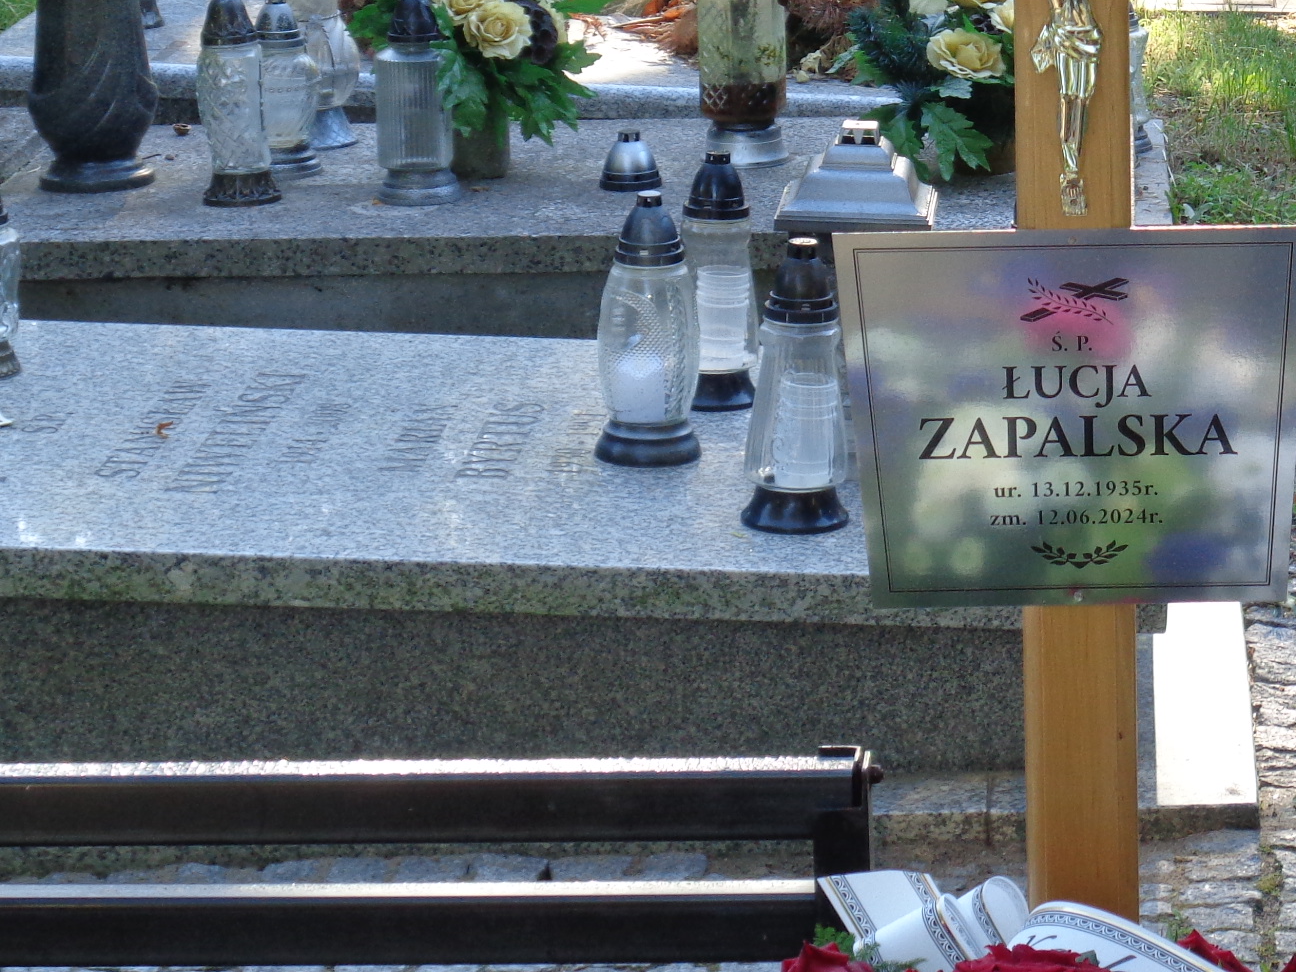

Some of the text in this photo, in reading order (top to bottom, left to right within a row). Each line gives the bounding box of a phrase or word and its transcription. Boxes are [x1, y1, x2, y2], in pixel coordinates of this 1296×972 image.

[1051, 331, 1093, 352] Ś. P.
[1001, 364, 1152, 408] ŁUCJA
[453, 402, 546, 479] BYRTUS
[918, 413, 1238, 460] ZAPALSKA
[994, 480, 1159, 498] ur. 13.12.1935r.
[989, 508, 1164, 526] zm. 12.06.2024r.
